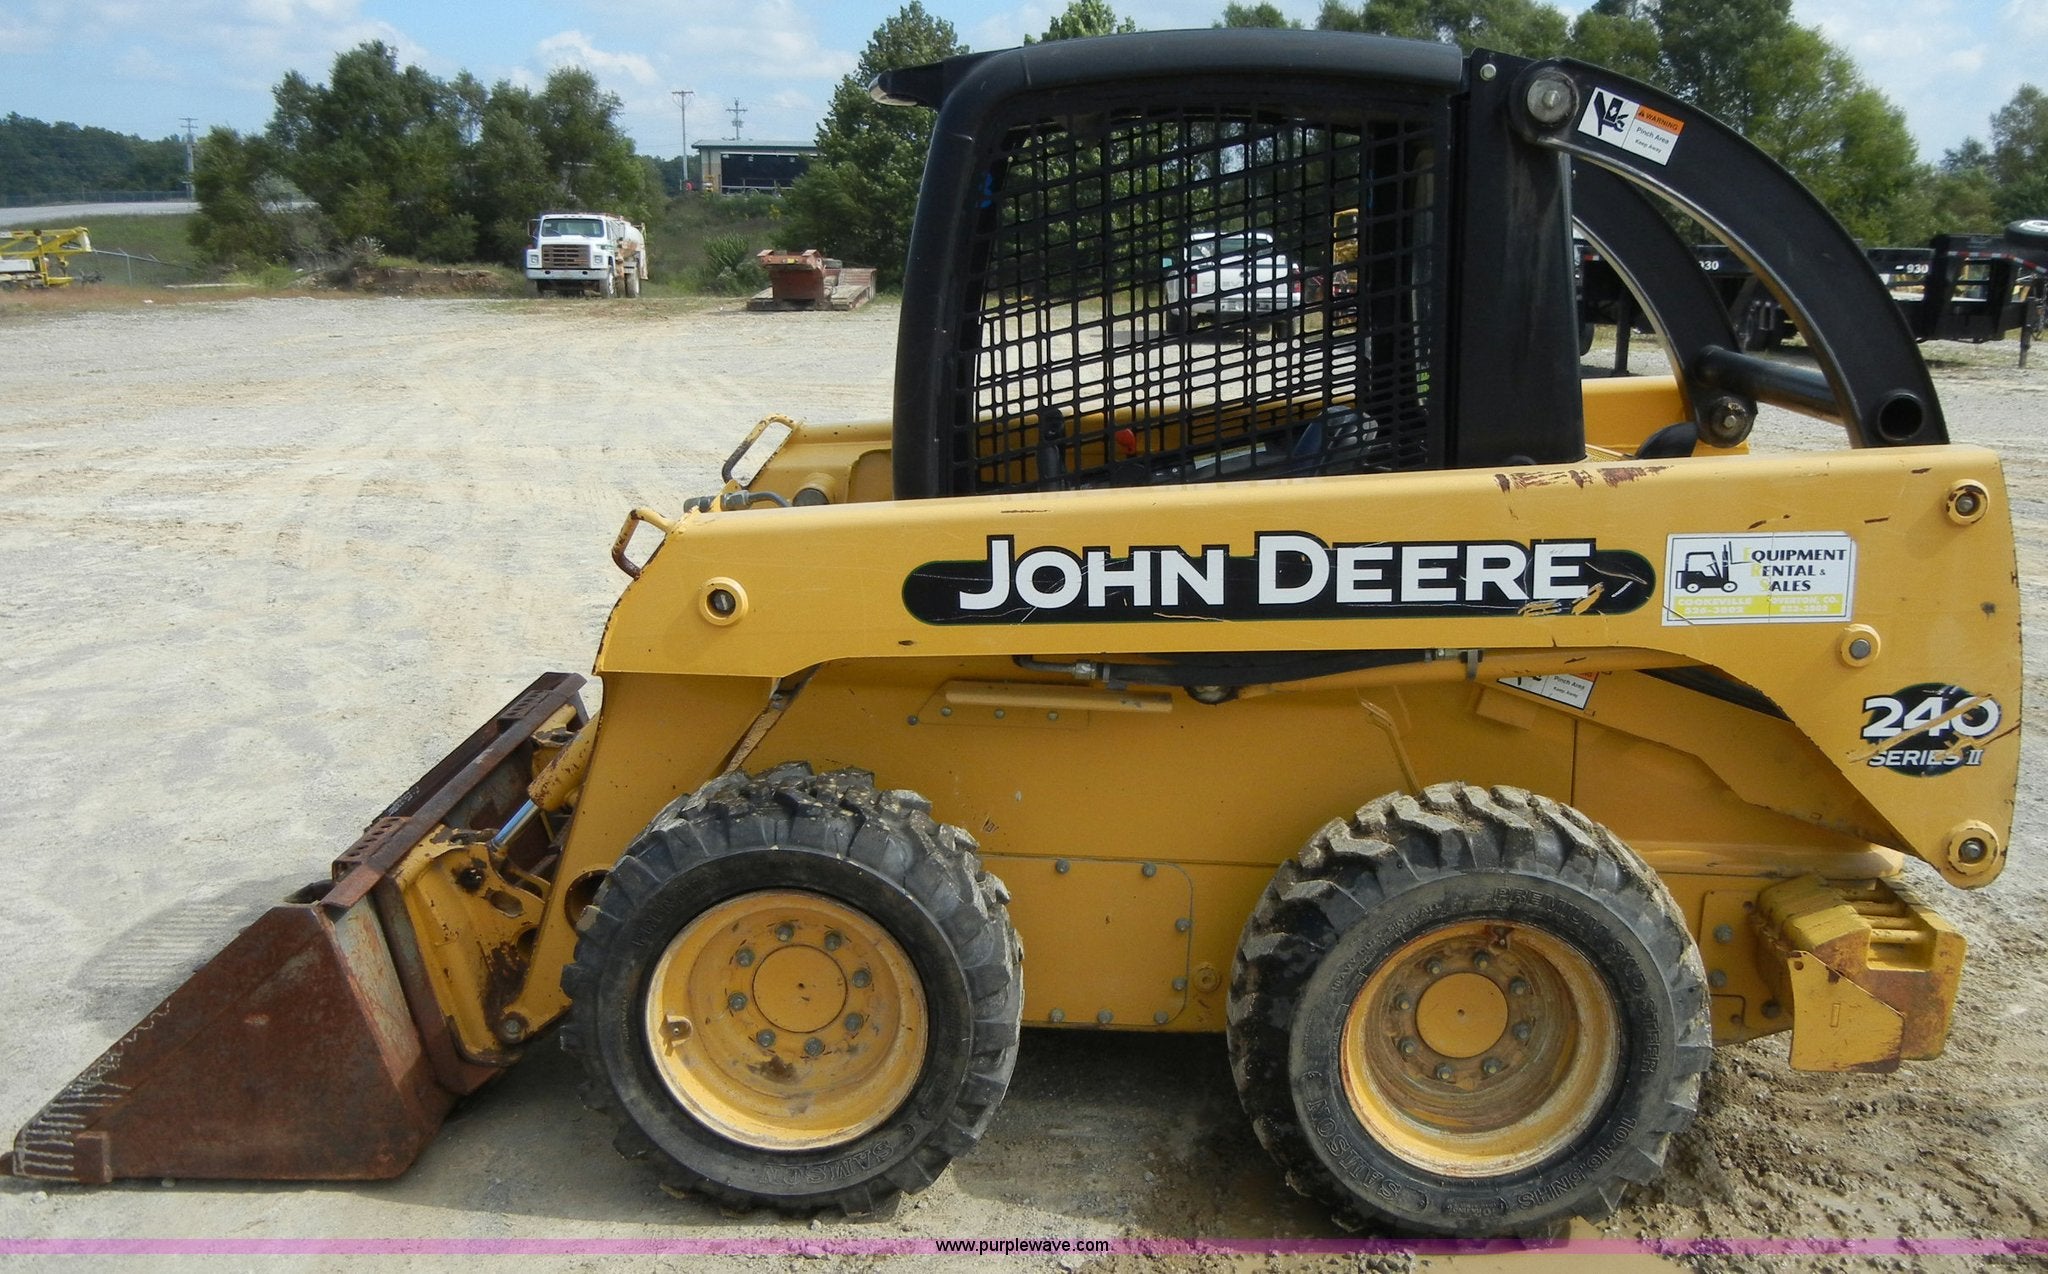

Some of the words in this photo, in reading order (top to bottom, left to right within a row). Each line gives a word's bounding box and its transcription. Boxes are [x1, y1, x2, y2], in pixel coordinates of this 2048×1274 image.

[1645, 114, 1678, 131] WARNING
[1636, 126, 1654, 138] Pinch
[1655, 134, 1670, 144] Area
[1635, 139, 1648, 149] Keep
[1648, 143, 1662, 154] Away
[1906, 263, 1930, 274] 930
[1744, 547, 1847, 564] EQUIPMENT
[959, 539, 1226, 612] JOHN
[1257, 535, 1594, 606] DEERE
[1751, 563, 1816, 577] RENTAL
[1760, 578, 1811, 592] SALES
[1553, 676, 1571, 686] Pinch
[1571, 681, 1585, 690] Area
[1862, 696, 2000, 737] 240
[1869, 749, 1962, 767] SERIES
[1640, 998, 1661, 1073] STEER
[1306, 1099, 1402, 1200] SAMSON
